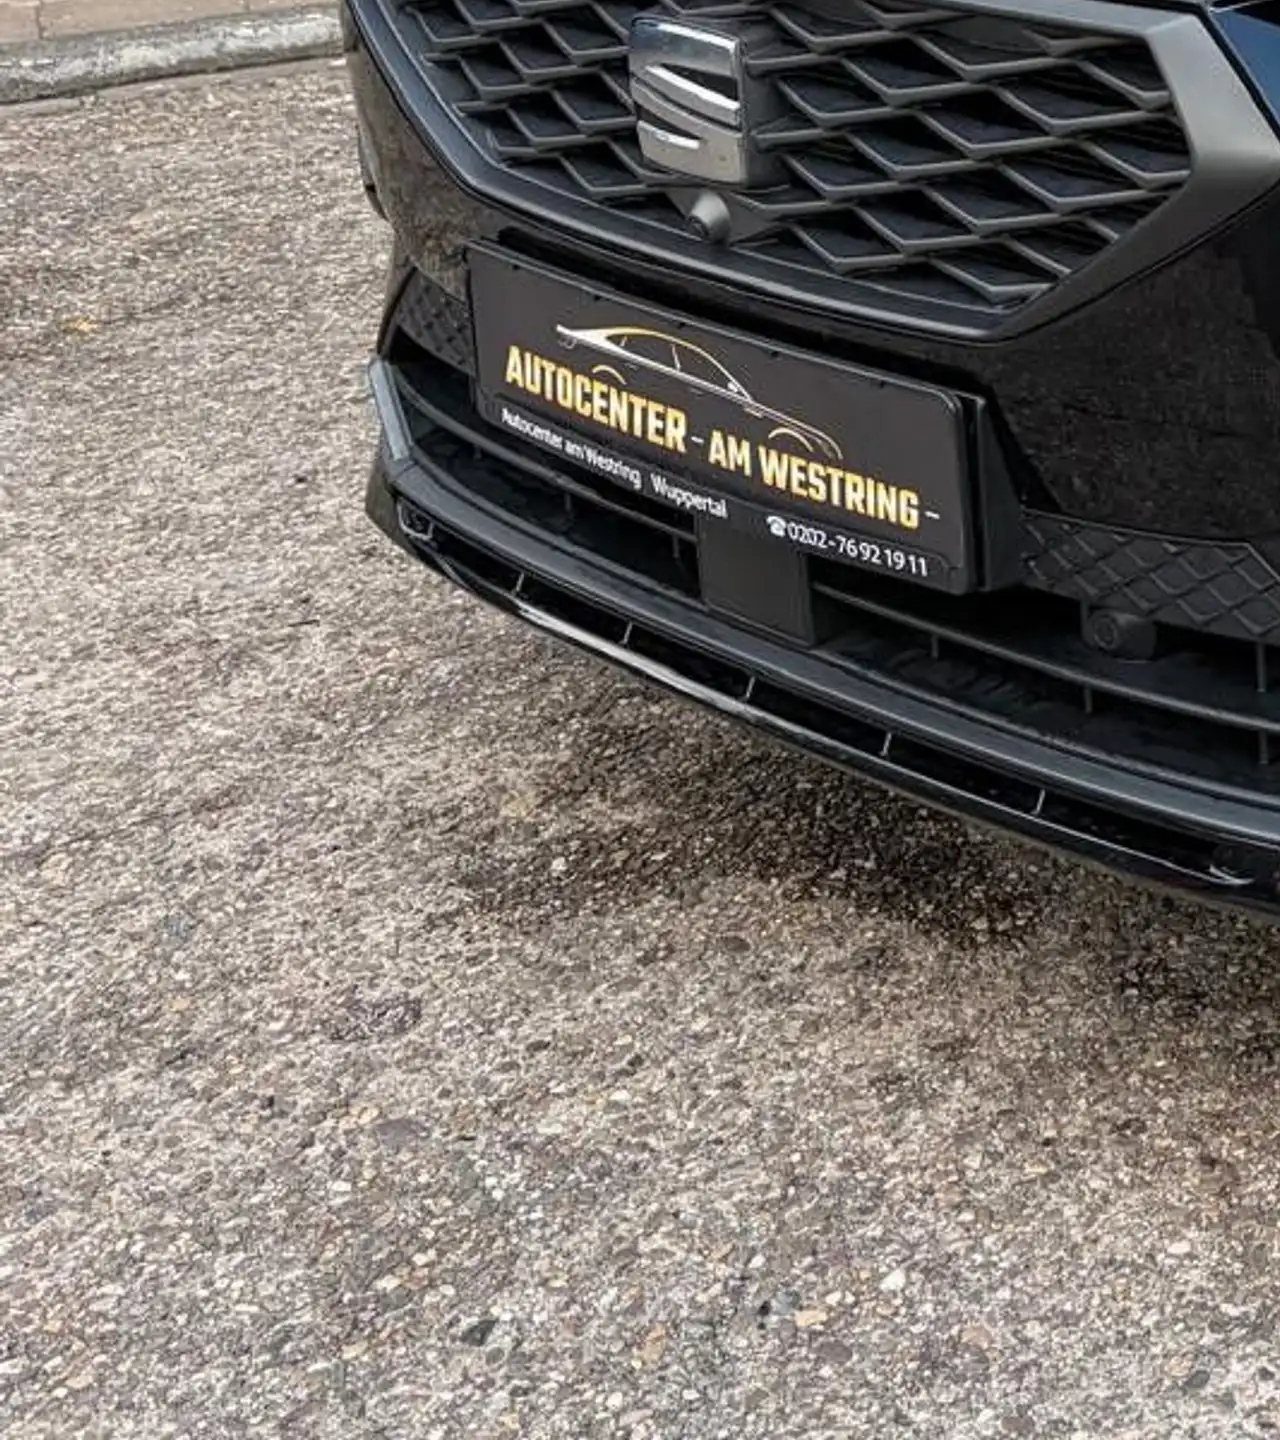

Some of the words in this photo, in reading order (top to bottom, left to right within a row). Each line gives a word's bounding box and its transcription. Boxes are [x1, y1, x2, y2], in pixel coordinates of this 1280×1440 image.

[501, 407, 564, 451] Autocenter
[564, 439, 584, 460] am
[583, 444, 643, 490] Westring
[649, 472, 729, 519] Wuppertal
[505, 344, 687, 454] AUTOCENTER
[708, 429, 752, 477] AM
[757, 444, 920, 530] WESTRING
